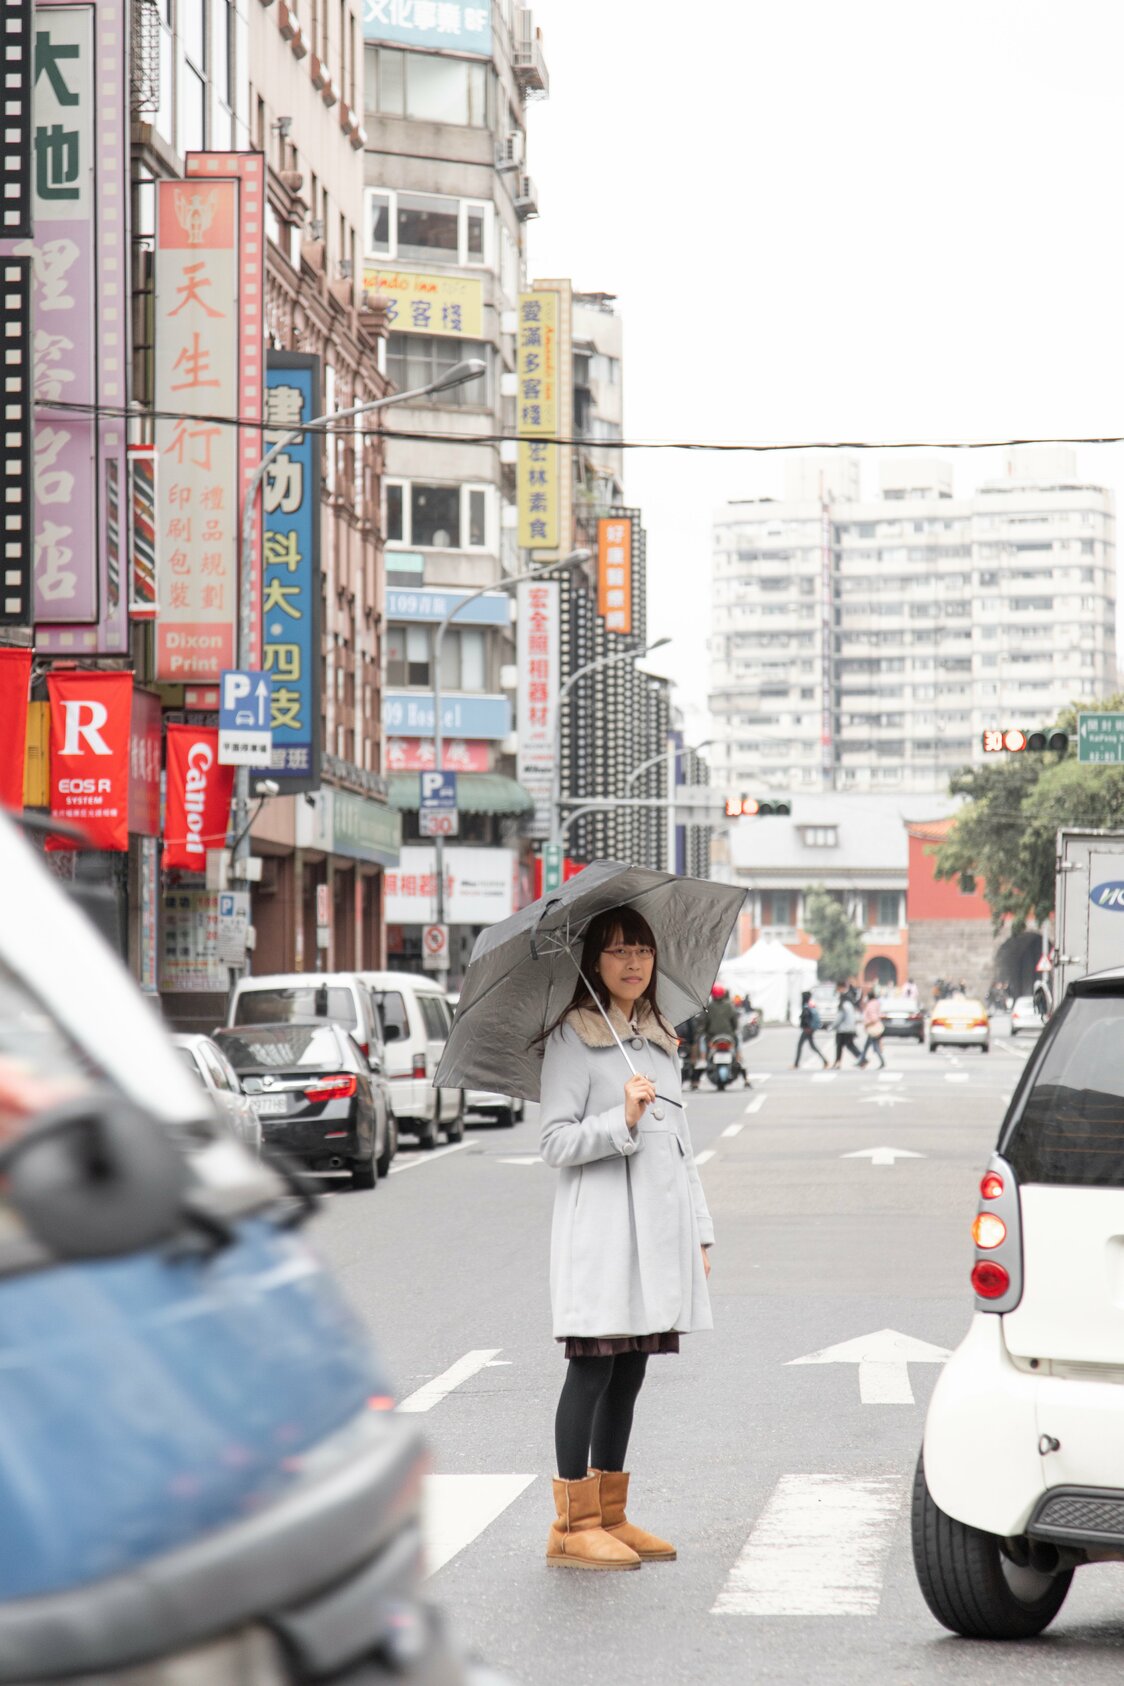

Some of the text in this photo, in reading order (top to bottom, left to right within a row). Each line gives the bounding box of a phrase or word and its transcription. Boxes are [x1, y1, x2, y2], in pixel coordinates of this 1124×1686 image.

[163, 262, 226, 472] 天生行
[166, 483, 193, 610] 印刷包裝
[200, 485, 228, 612] 禮品規劃
[165, 631, 223, 650] Dixon
[169, 655, 219, 673] Print
[224, 674, 251, 711] P
[57, 700, 113, 756] R
[407, 703, 461, 728] Hosel
[58, 778, 111, 793] EOS R
[184, 742, 213, 853] Canon
[422, 772, 444, 798] P
[66, 796, 103, 805] SYSTEM
[222, 898, 232, 914] P
